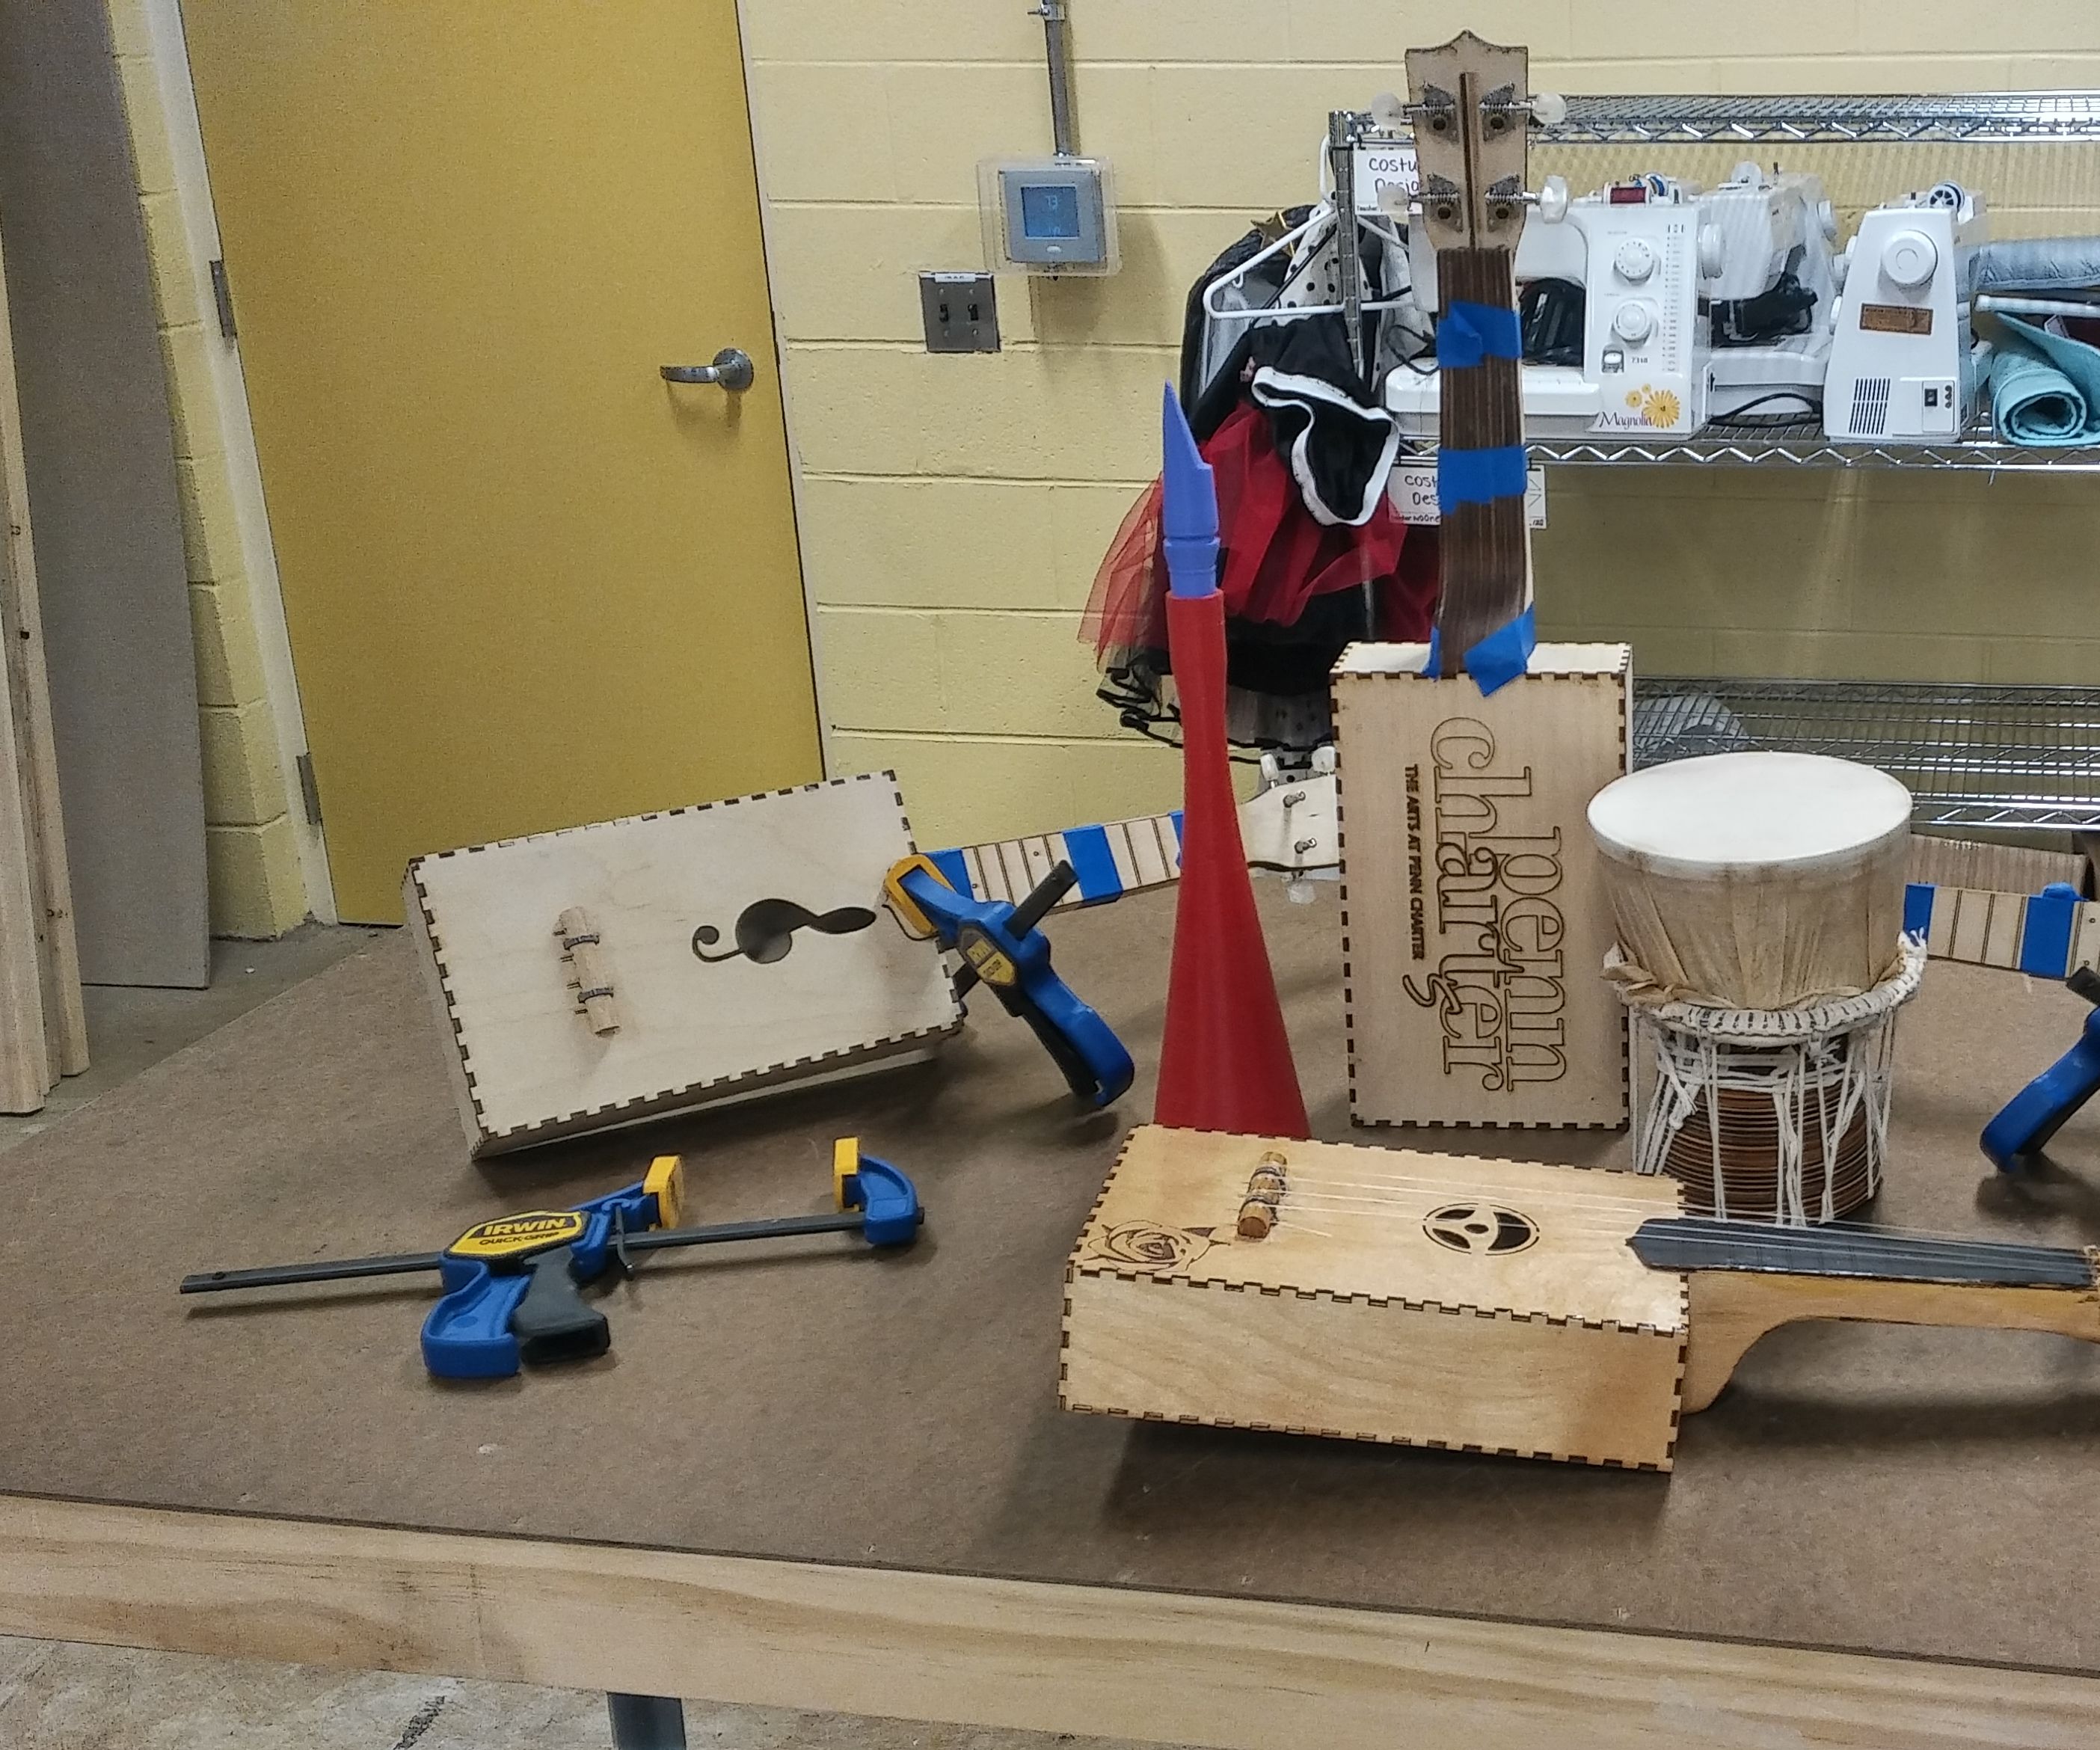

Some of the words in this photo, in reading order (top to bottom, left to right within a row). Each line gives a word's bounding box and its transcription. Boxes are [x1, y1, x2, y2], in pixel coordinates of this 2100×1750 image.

[1599, 411, 1654, 430] Magnolia
[1412, 491, 1438, 506] Des
[1405, 764, 1419, 792] THE
[1407, 794, 1420, 831] ARTS
[1408, 833, 1421, 853] AT
[482, 1218, 566, 1236] IRWIN
